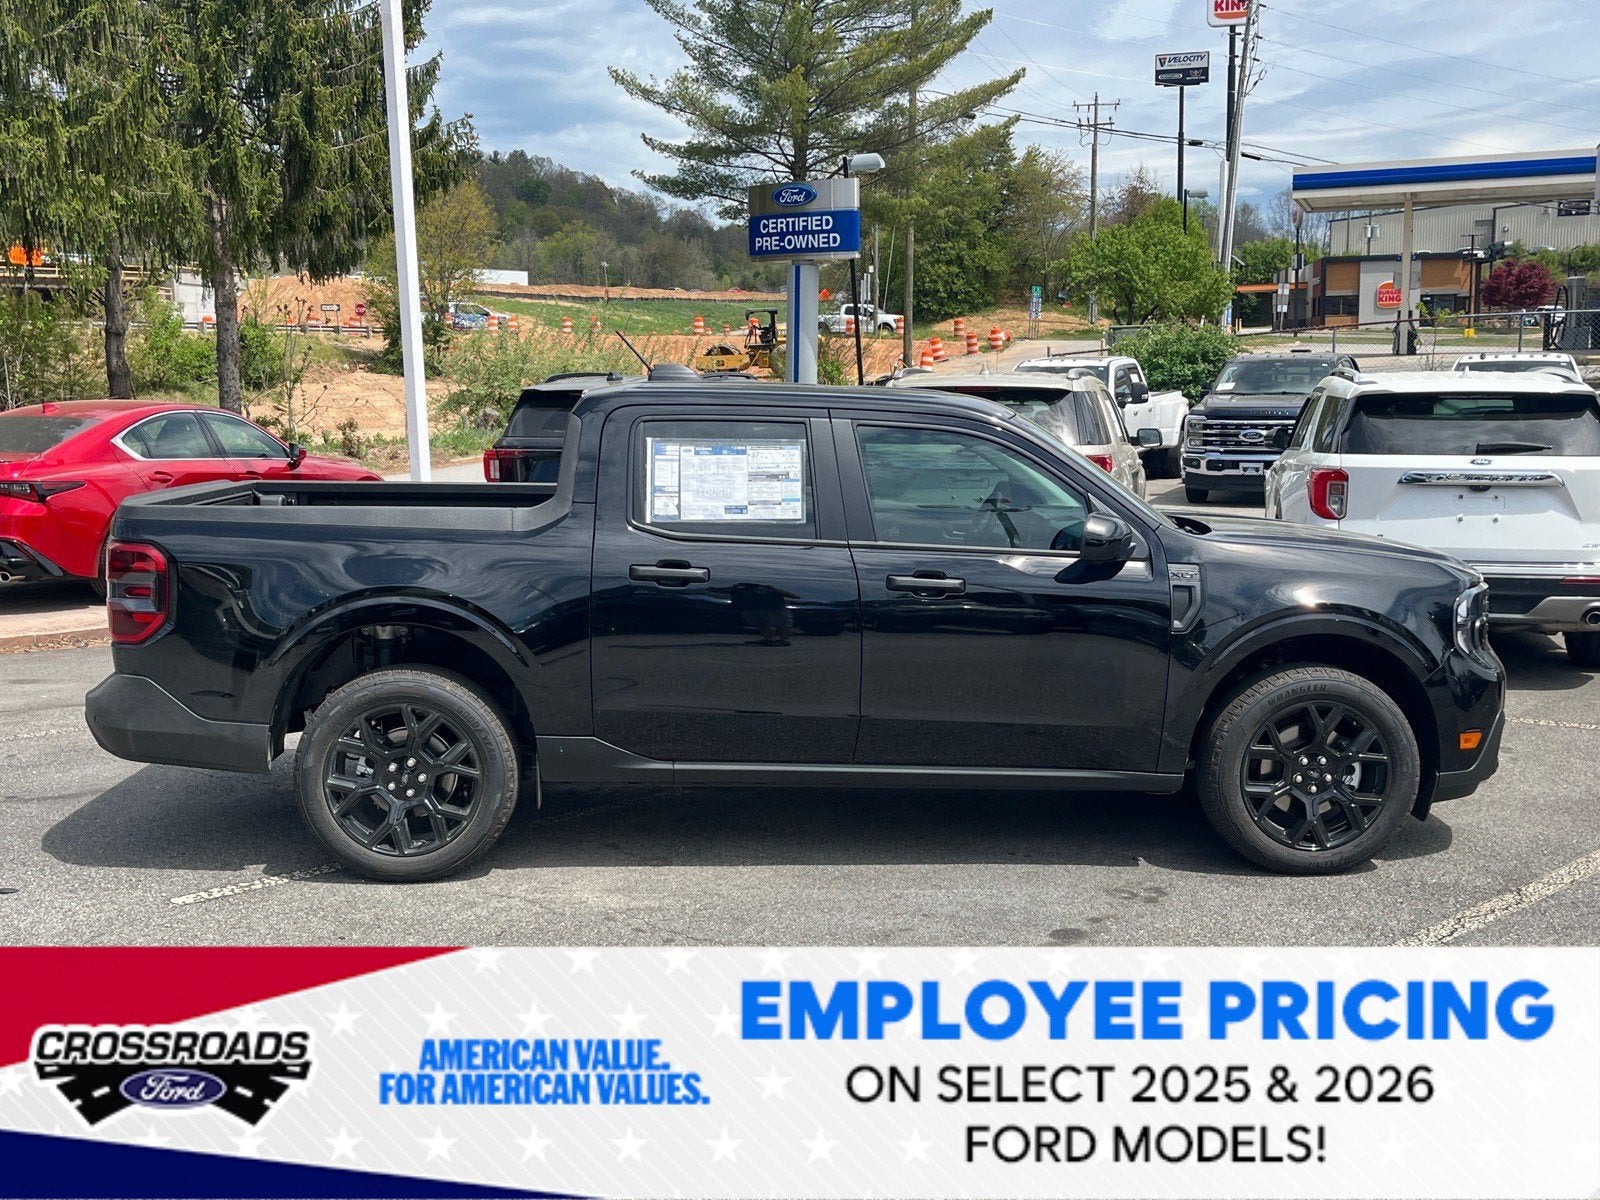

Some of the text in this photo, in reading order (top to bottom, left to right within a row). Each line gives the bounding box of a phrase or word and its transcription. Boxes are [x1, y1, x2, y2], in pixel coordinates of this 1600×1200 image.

[1167, 54, 1206, 64] VELOCITY
[779, 188, 806, 204] Ford
[759, 215, 834, 234] CERTIFIED
[755, 232, 841, 251] PRE-OWNED
[1378, 294, 1401, 302] KING
[1170, 571, 1198, 579] XLT
[1266, 683, 1328, 705] WRANGLER
